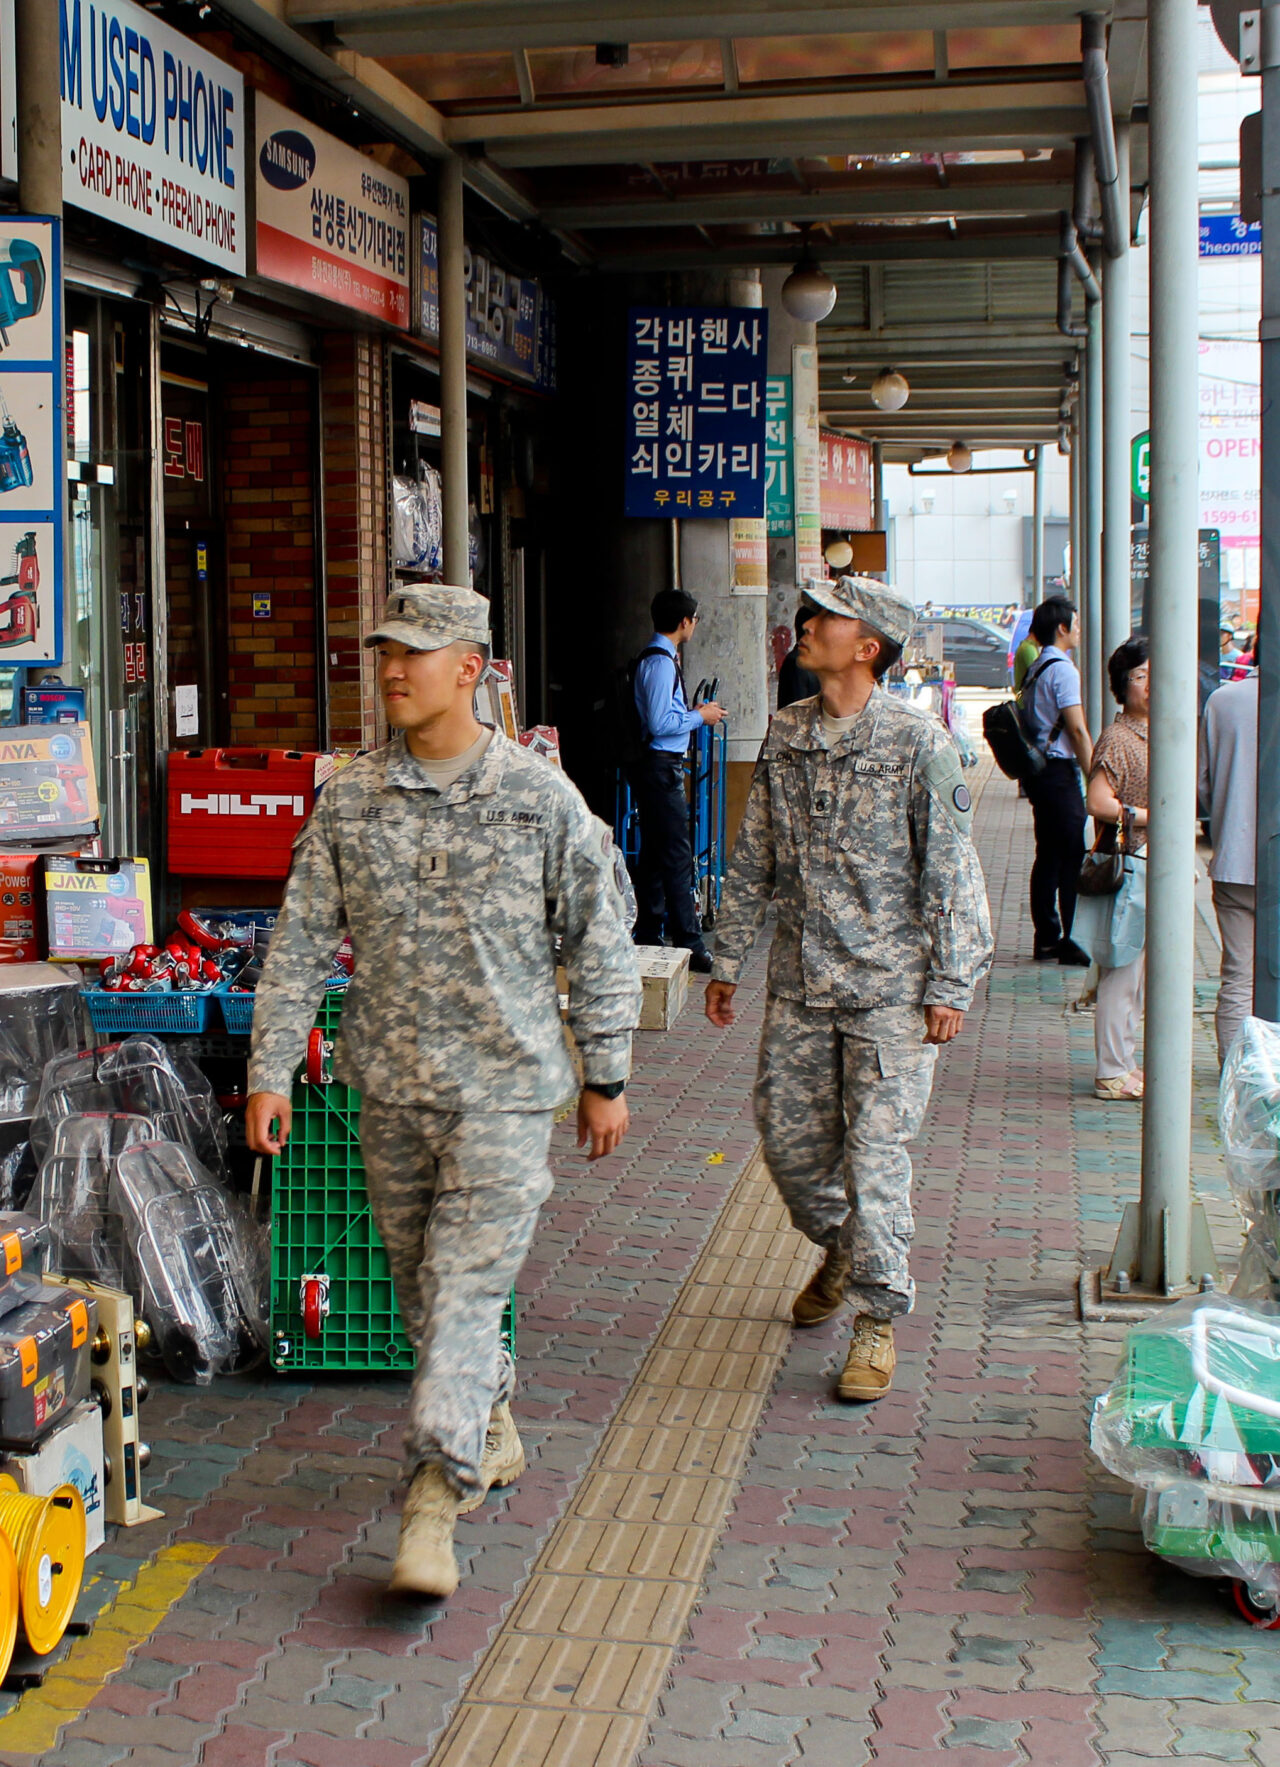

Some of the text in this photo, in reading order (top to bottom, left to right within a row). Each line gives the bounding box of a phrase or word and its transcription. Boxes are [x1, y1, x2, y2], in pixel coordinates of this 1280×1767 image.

[89, 3, 156, 146] USED
[163, 50, 235, 190] PHONE
[266, 139, 312, 184] SAMSUNG
[78, 136, 236, 254] CARD PHONE PREPAID PHONE
[310, 187, 406, 277] 삼성통신기기대리점
[731, 319, 762, 479] 사다리
[860, 762, 905, 775] U.S. ARMY
[180, 793, 304, 816] HILTI
[361, 807, 382, 819] LEE
[486, 810, 544, 825] U.S. ARMY
[53, 876, 97, 890] JAYA
